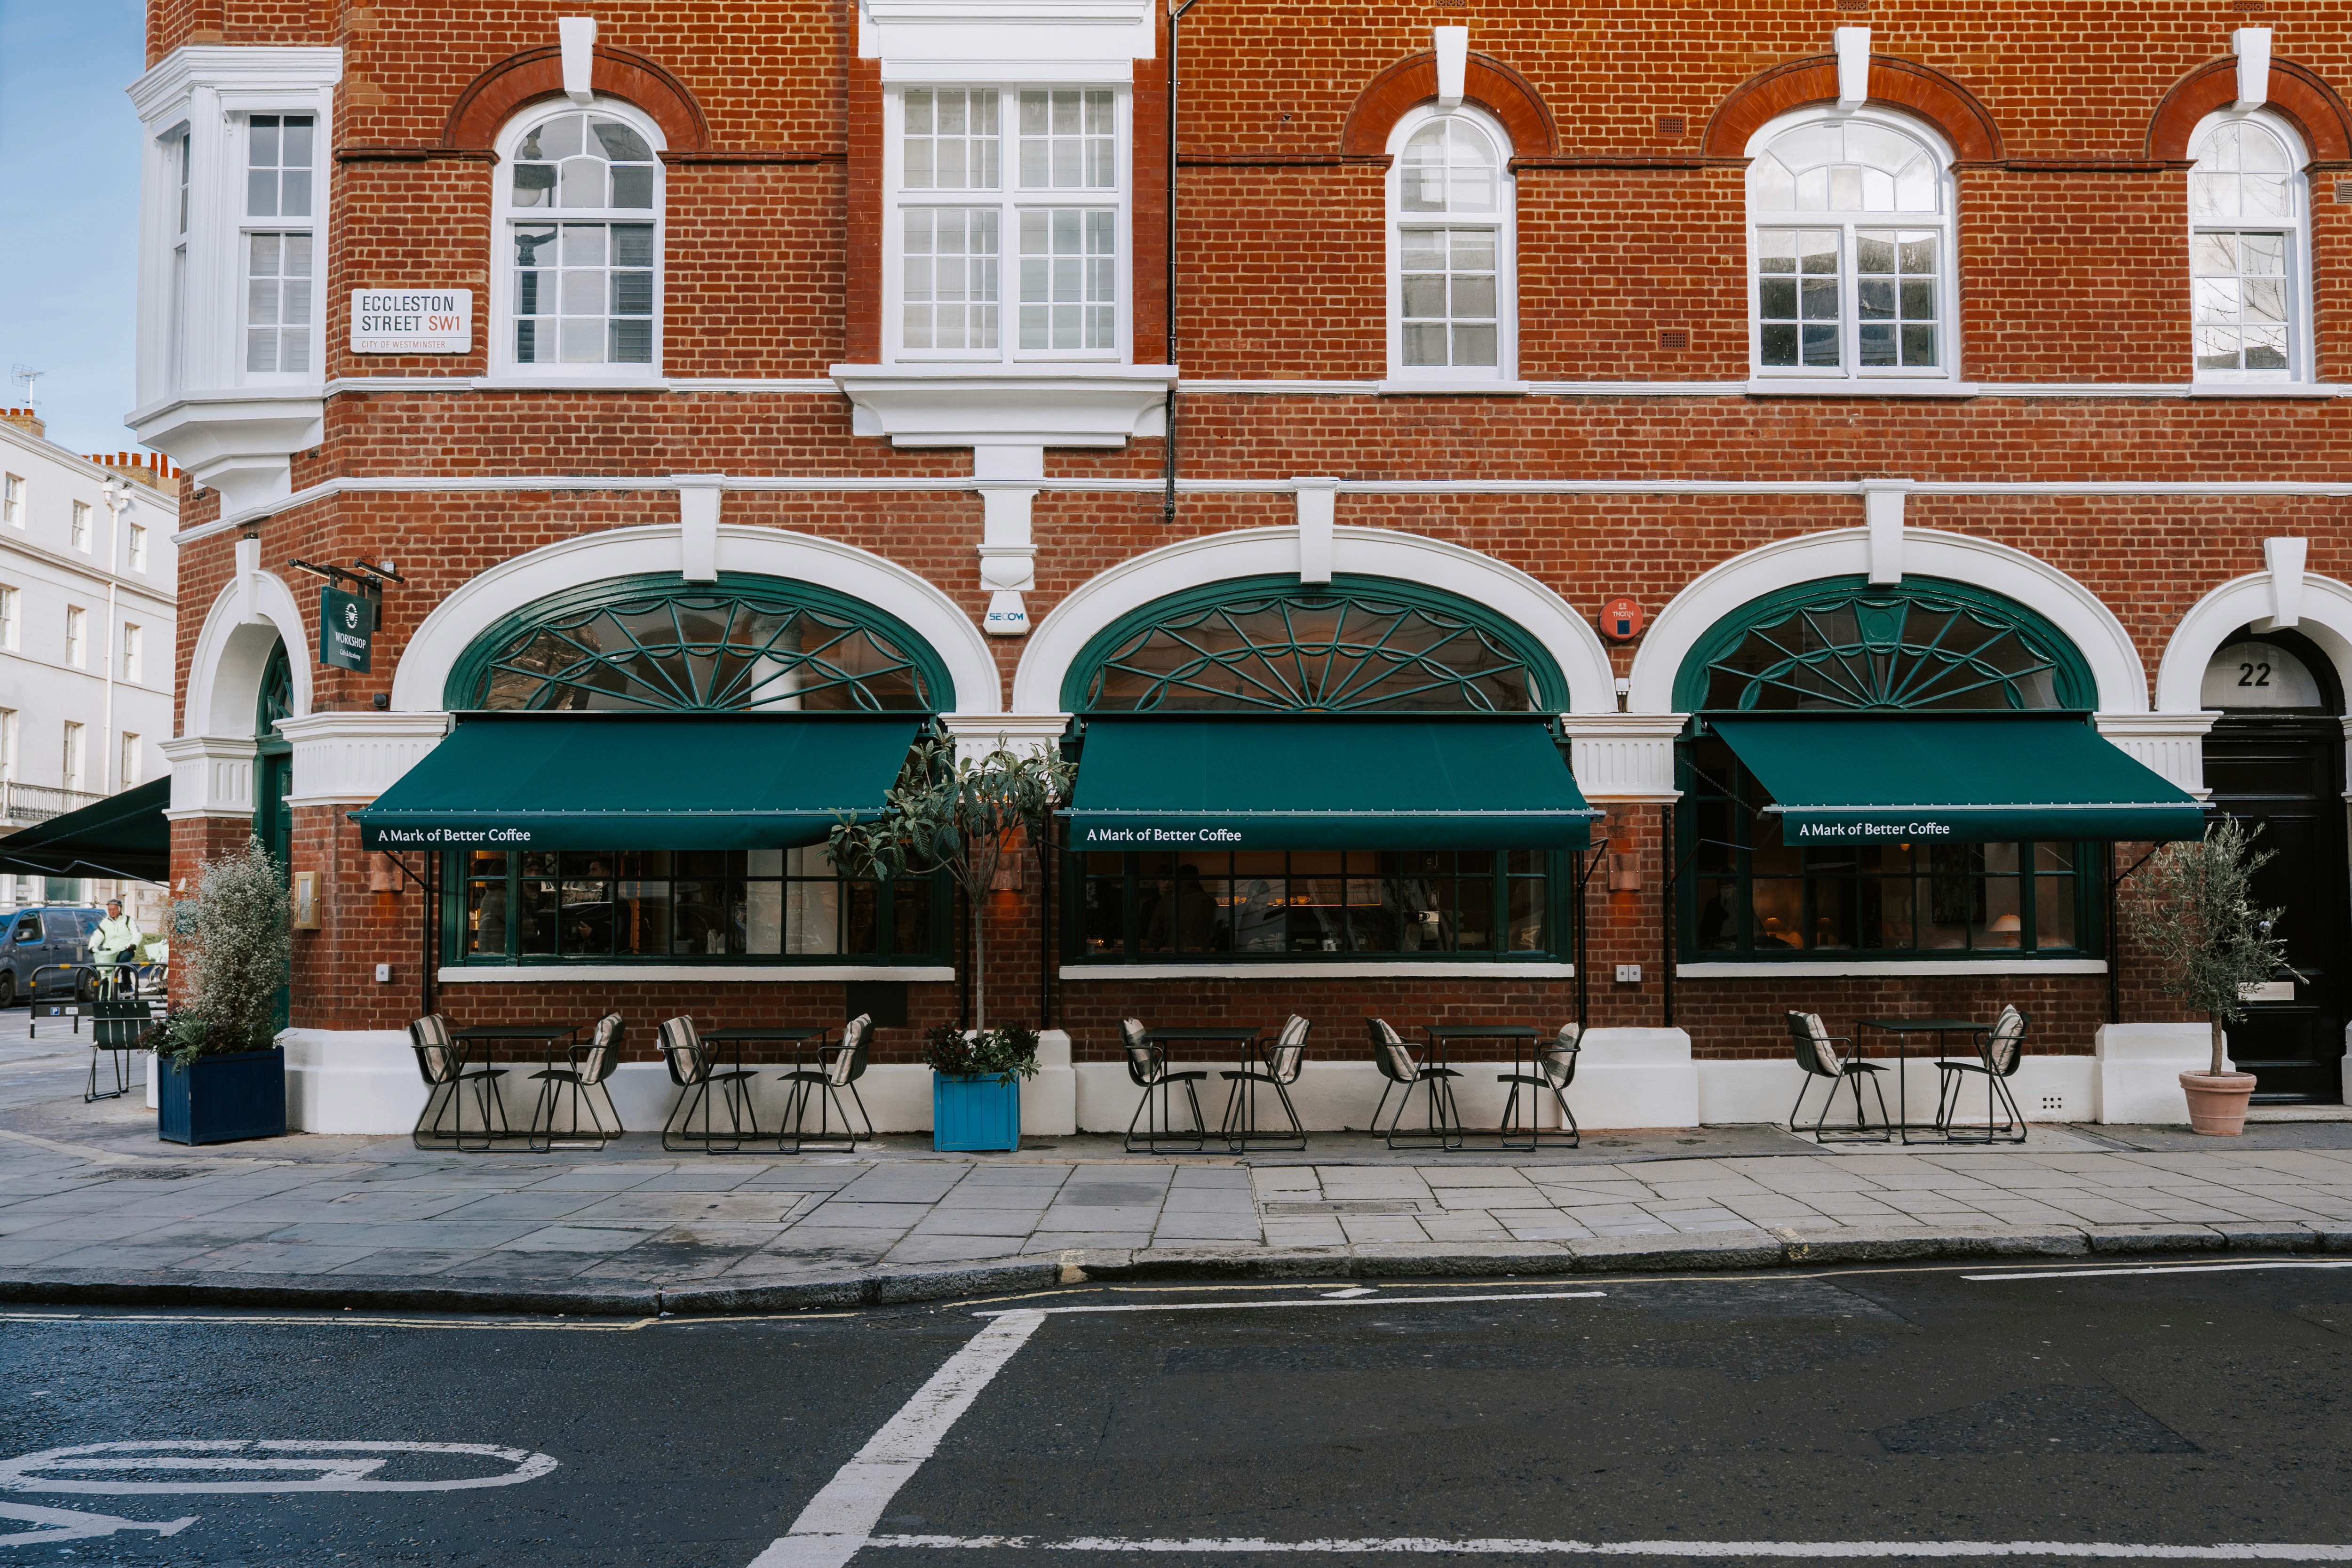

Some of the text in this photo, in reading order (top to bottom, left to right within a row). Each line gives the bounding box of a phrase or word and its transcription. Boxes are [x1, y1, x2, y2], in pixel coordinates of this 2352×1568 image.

[363, 296, 453, 311] ECCLESTON
[362, 316, 460, 331] STREET SW1
[335, 631, 366, 649] WORKSHOP
[2238, 663, 2271, 686] 22
[378, 828, 531, 841] A Mark of Better Coffee
[1087, 828, 1241, 841] A Mark of Better Coffee
[1799, 822, 1950, 836] A Mark of Better Coffee
